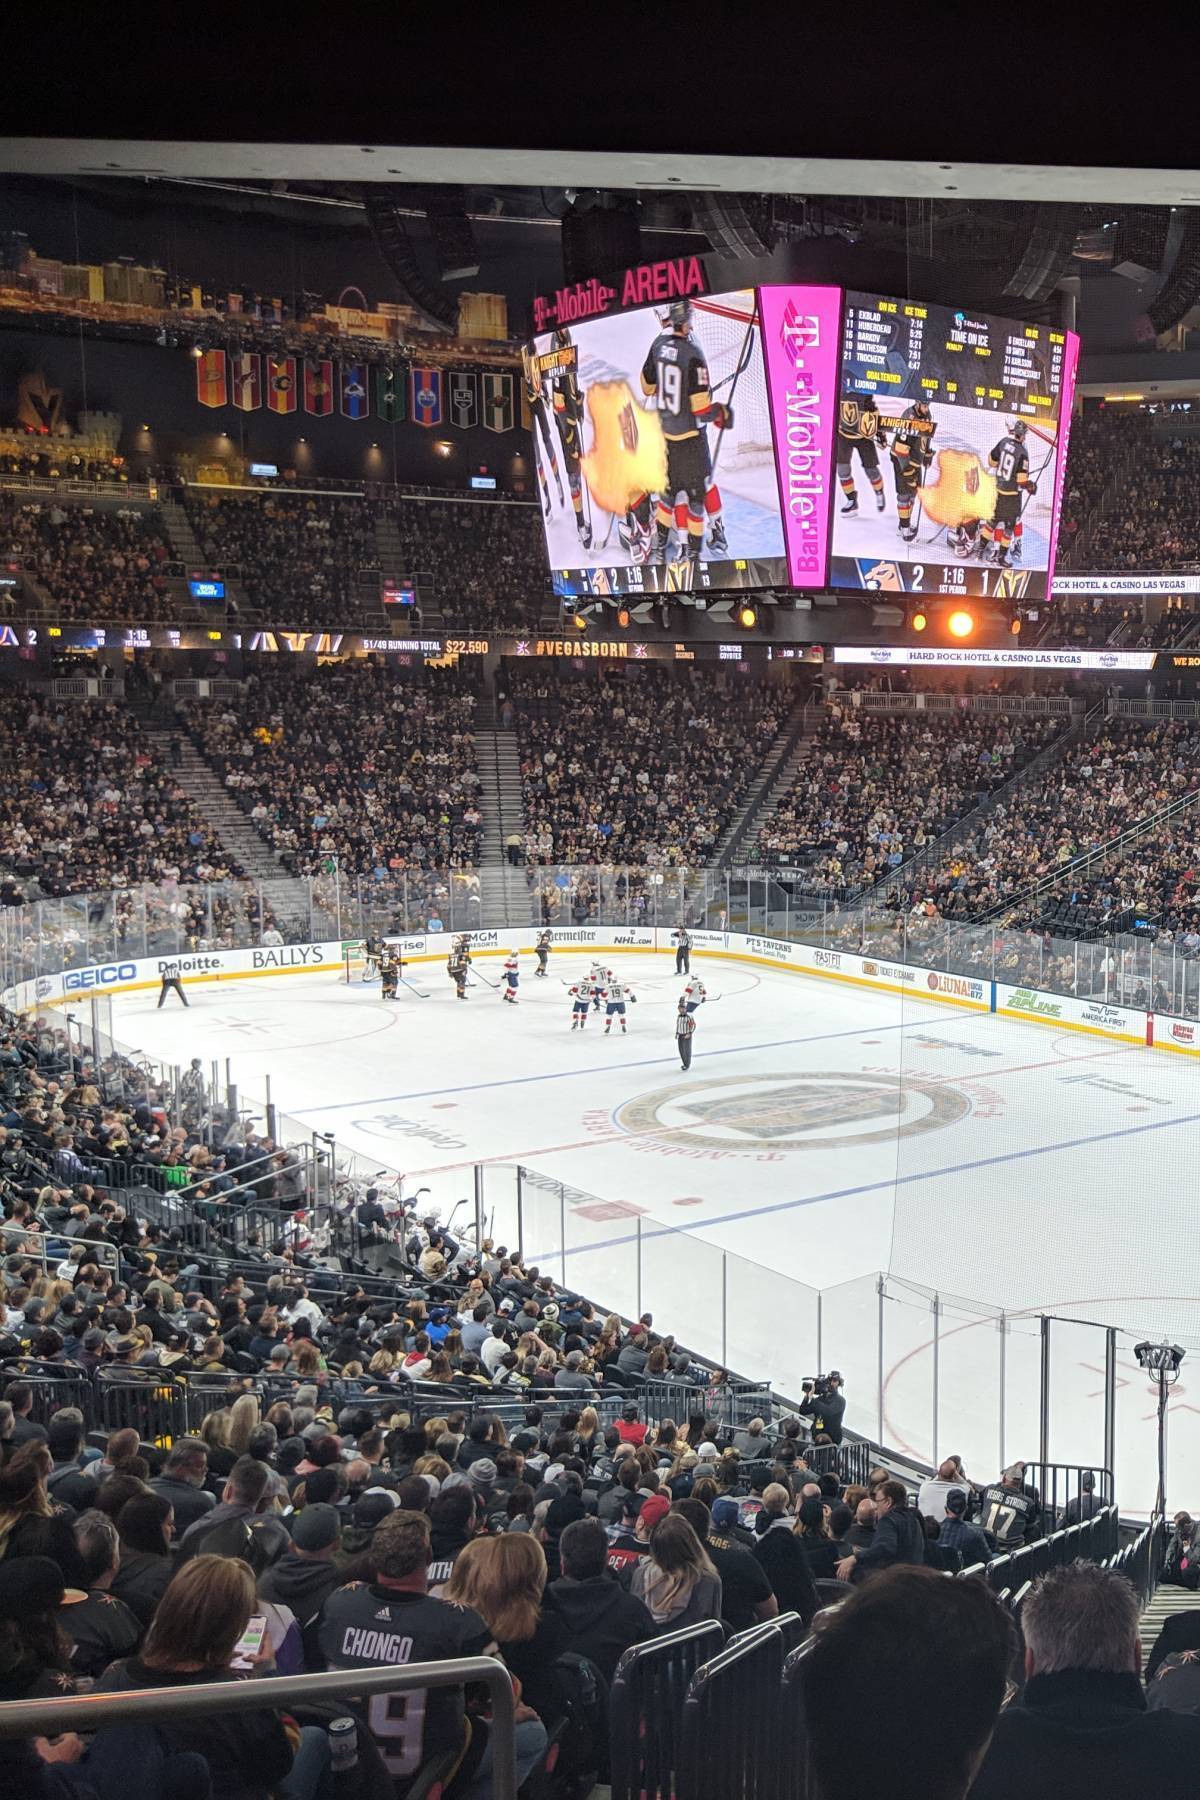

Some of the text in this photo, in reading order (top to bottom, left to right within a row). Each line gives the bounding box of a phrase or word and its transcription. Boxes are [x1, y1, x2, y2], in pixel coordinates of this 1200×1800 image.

[621, 256, 704, 305] ARENA
[858, 310, 923, 329] EKBLAD 7:14
[858, 332, 881, 343] BARKOV
[951, 330, 989, 347] TIME ON ICE
[857, 342, 887, 354] MATHESON
[844, 352, 921, 370] 21 TROCHECK 4:47
[658, 361, 682, 415] 19
[855, 379, 877, 390] LUONGO
[921, 378, 938, 389] SAVES
[997, 451, 1015, 481] 19
[612, 571, 618, 590] 2
[626, 567, 642, 584] 1:16
[652, 567, 659, 590] 1
[912, 565, 924, 590] 2
[943, 568, 964, 584] 1:16
[981, 570, 989, 595] 1
[939, 584, 966, 594] 1ST PERIOD
[1052, 581, 1070, 589] OCK
[1073, 581, 1100, 589] HOTEL
[1110, 581, 1141, 589] CASINO
[1160, 580, 1185, 588] VEGAS
[29, 631, 38, 644] 2
[128, 630, 147, 640] 1:16
[235, 635, 241, 647] 1
[363, 640, 488, 654] 51/49 RUNNING TOTAL $22,590
[536, 641, 628, 656] #VEGASBORN
[910, 652, 934, 660] HARD
[937, 652, 961, 661] ROCK
[964, 653, 991, 661] HOTEL
[1002, 654, 1033, 663] CASINO
[1035, 655, 1051, 663] LAS
[1054, 655, 1081, 663] VEGAS
[1173, 657, 1187, 666] WE
[469, 932, 498, 941] MGM
[763, 940, 792, 953] TAVERNS
[253, 946, 323, 969] BALLY'S
[66, 964, 136, 989] GEICO
[581, 986, 590, 995] 21
[612, 989, 620, 998] 19
[970, 991, 983, 1000] 872
[1082, 1012, 1107, 1023] AMERICA
[1109, 1017, 1126, 1027] FIRST
[987, 1489, 1028, 1512] VEGAS STRONG
[986, 1502, 1016, 1538] 17
[342, 1627, 413, 1663] CHONGO
